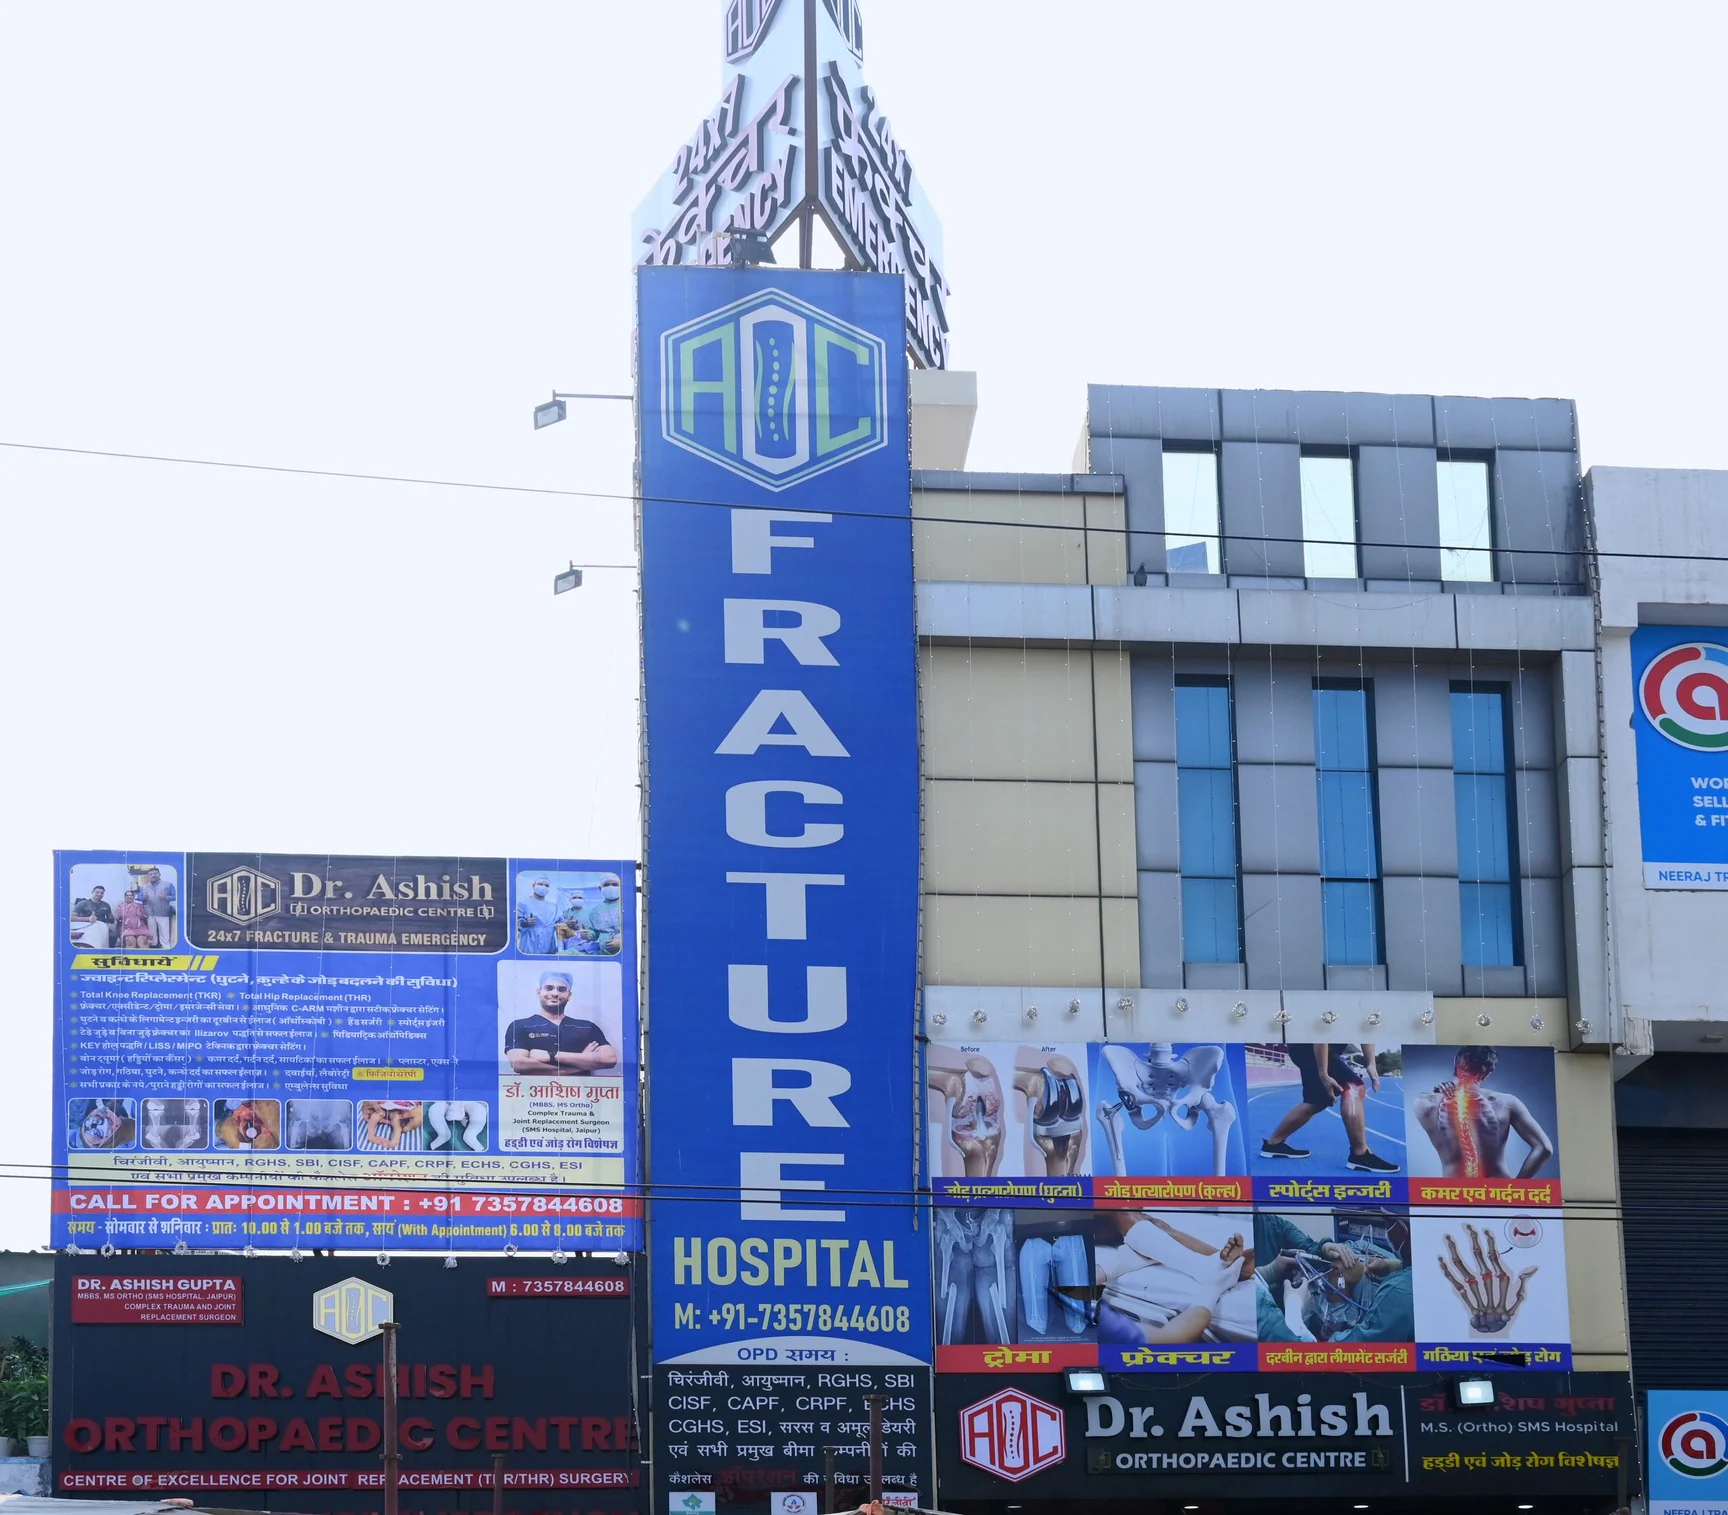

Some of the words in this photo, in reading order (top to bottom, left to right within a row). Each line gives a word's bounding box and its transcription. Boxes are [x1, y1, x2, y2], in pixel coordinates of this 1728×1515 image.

[1695, 815, 1707, 826] &
[714, 508, 851, 1224] FRACTURE
[1659, 871, 1711, 882] NEERAJ
[290, 872, 353, 899] Dr.
[367, 874, 494, 901] Ashish
[310, 905, 414, 917] ORTHOPAEDIC
[419, 907, 474, 918] CENTRE
[207, 930, 241, 942] 24x7
[246, 931, 319, 943] FRACTURE
[324, 933, 334, 944] &
[340, 932, 397, 945] TRAUMA
[402, 933, 486, 946] EMERGENCY
[81, 991, 104, 999] Total
[131, 992, 193, 1000] Replacement
[194, 991, 222, 1000] (TKR)
[240, 992, 263, 1000] Total
[265, 993, 280, 1001] Hip
[282, 993, 343, 1001] Replacement
[344, 994, 372, 1003] (THR)
[81, 1042, 101, 1050] KEY
[149, 1042, 171, 1050] LISS
[503, 1082, 525, 1099] डॉ.
[527, 1110, 559, 1118] Complex
[532, 1118, 578, 1127] Replacement
[580, 1119, 610, 1127] Surgeon
[542, 1127, 573, 1135] Hospital,
[575, 1127, 602, 1135] Jaipur)
[245, 1159, 290, 1169] RGHS,
[295, 1159, 323, 1169] SBI,
[328, 1159, 363, 1169] CISF,
[368, 1160, 411, 1169] CAPF,
[414, 1160, 457, 1170] CRPF,
[461, 1161, 505, 1170] ECHS,
[509, 1161, 557, 1170] CGHS,
[559, 1162, 583, 1170] ESI
[70, 1195, 137, 1210] CALL
[146, 1195, 197, 1210] FOR
[205, 1194, 395, 1212] APPOINTMENT
[419, 1197, 462, 1212] +91
[472, 1197, 623, 1213] 7357844608
[68, 1220, 95, 1234] समय
[241, 1221, 278, 1235] 10.00
[294, 1222, 322, 1236] 1.00
[398, 1223, 429, 1238] (With
[431, 1223, 508, 1239] Appointment)
[510, 1223, 539, 1237] 6.00
[553, 1224, 582, 1238] 8.00
[674, 1237, 909, 1289] HOSPITAL
[77, 1279, 107, 1290] DR.
[110, 1279, 174, 1291] ASHISH
[177, 1280, 236, 1291] GUPTA
[491, 1281, 506, 1293] M
[523, 1281, 625, 1293] 7357844608
[77, 1293, 102, 1301] MBBS,
[145, 1293, 165, 1301] (SMS
[124, 1303, 162, 1311] COMPLEX
[674, 1302, 701, 1330] M:
[708, 1303, 910, 1333] +91-7357844608
[737, 1347, 778, 1361] OPD
[785, 1348, 836, 1362] समय
[211, 1364, 294, 1399] DR.
[668, 1371, 735, 1389] चिरंजीवी,
[741, 1375, 811, 1391] आयुष्मान,
[818, 1374, 878, 1389] RGHS,
[884, 1374, 915, 1388] SBI
[668, 1396, 718, 1413] CISF,
[727, 1397, 786, 1413] CAPF,
[796, 1397, 853, 1413] CRPF,
[1083, 1396, 1165, 1439] Dr.
[1178, 1392, 1394, 1437] Ashish
[64, 1417, 434, 1452] ORTHOPAEDC
[446, 1417, 639, 1451] CENTRE
[668, 1419, 730, 1436] CGHS,
[737, 1420, 773, 1435] ESI,
[779, 1421, 814, 1434] सरस
[1420, 1422, 1453, 1433] M.S.
[1457, 1422, 1513, 1434] (Ortho)
[1518, 1422, 1550, 1432] SMS
[1555, 1421, 1619, 1435] Hospital
[697, 1441, 729, 1457] सभी
[782, 1441, 815, 1457] बीमा
[1116, 1452, 1275, 1469] ORTHOPAEDIC
[1282, 1451, 1367, 1468] CENTRE
[63, 1475, 127, 1487] CENTRE
[132, 1475, 153, 1487] OF
[157, 1475, 261, 1486] EXCELLENCE
[266, 1474, 299, 1486] FOR
[302, 1473, 348, 1486] JOINT
